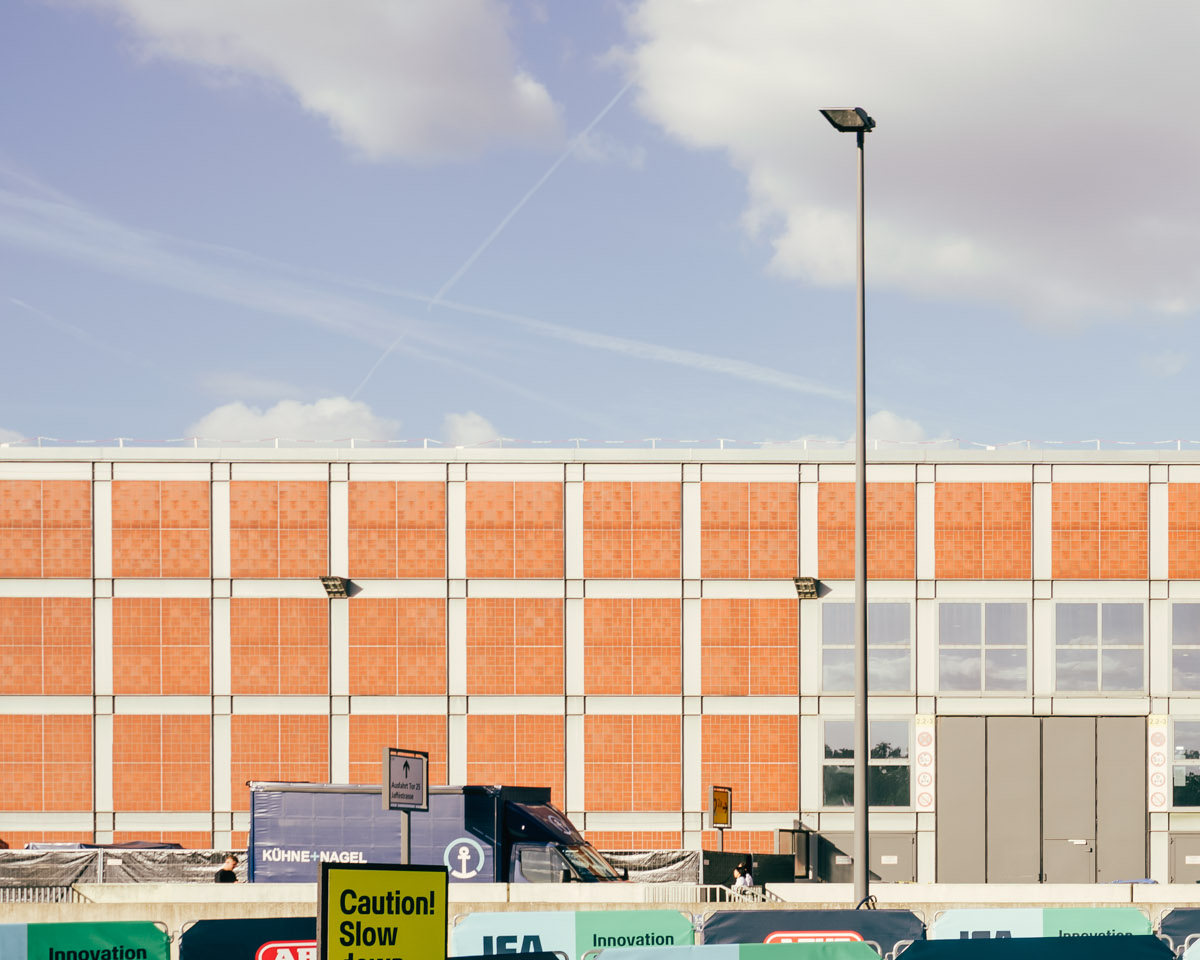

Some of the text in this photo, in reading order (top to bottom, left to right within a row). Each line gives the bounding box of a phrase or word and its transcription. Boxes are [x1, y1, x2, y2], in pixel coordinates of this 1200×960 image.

[340, 889, 435, 915] Caution!
[340, 921, 398, 946] Slow
[593, 932, 674, 947] Innovation
